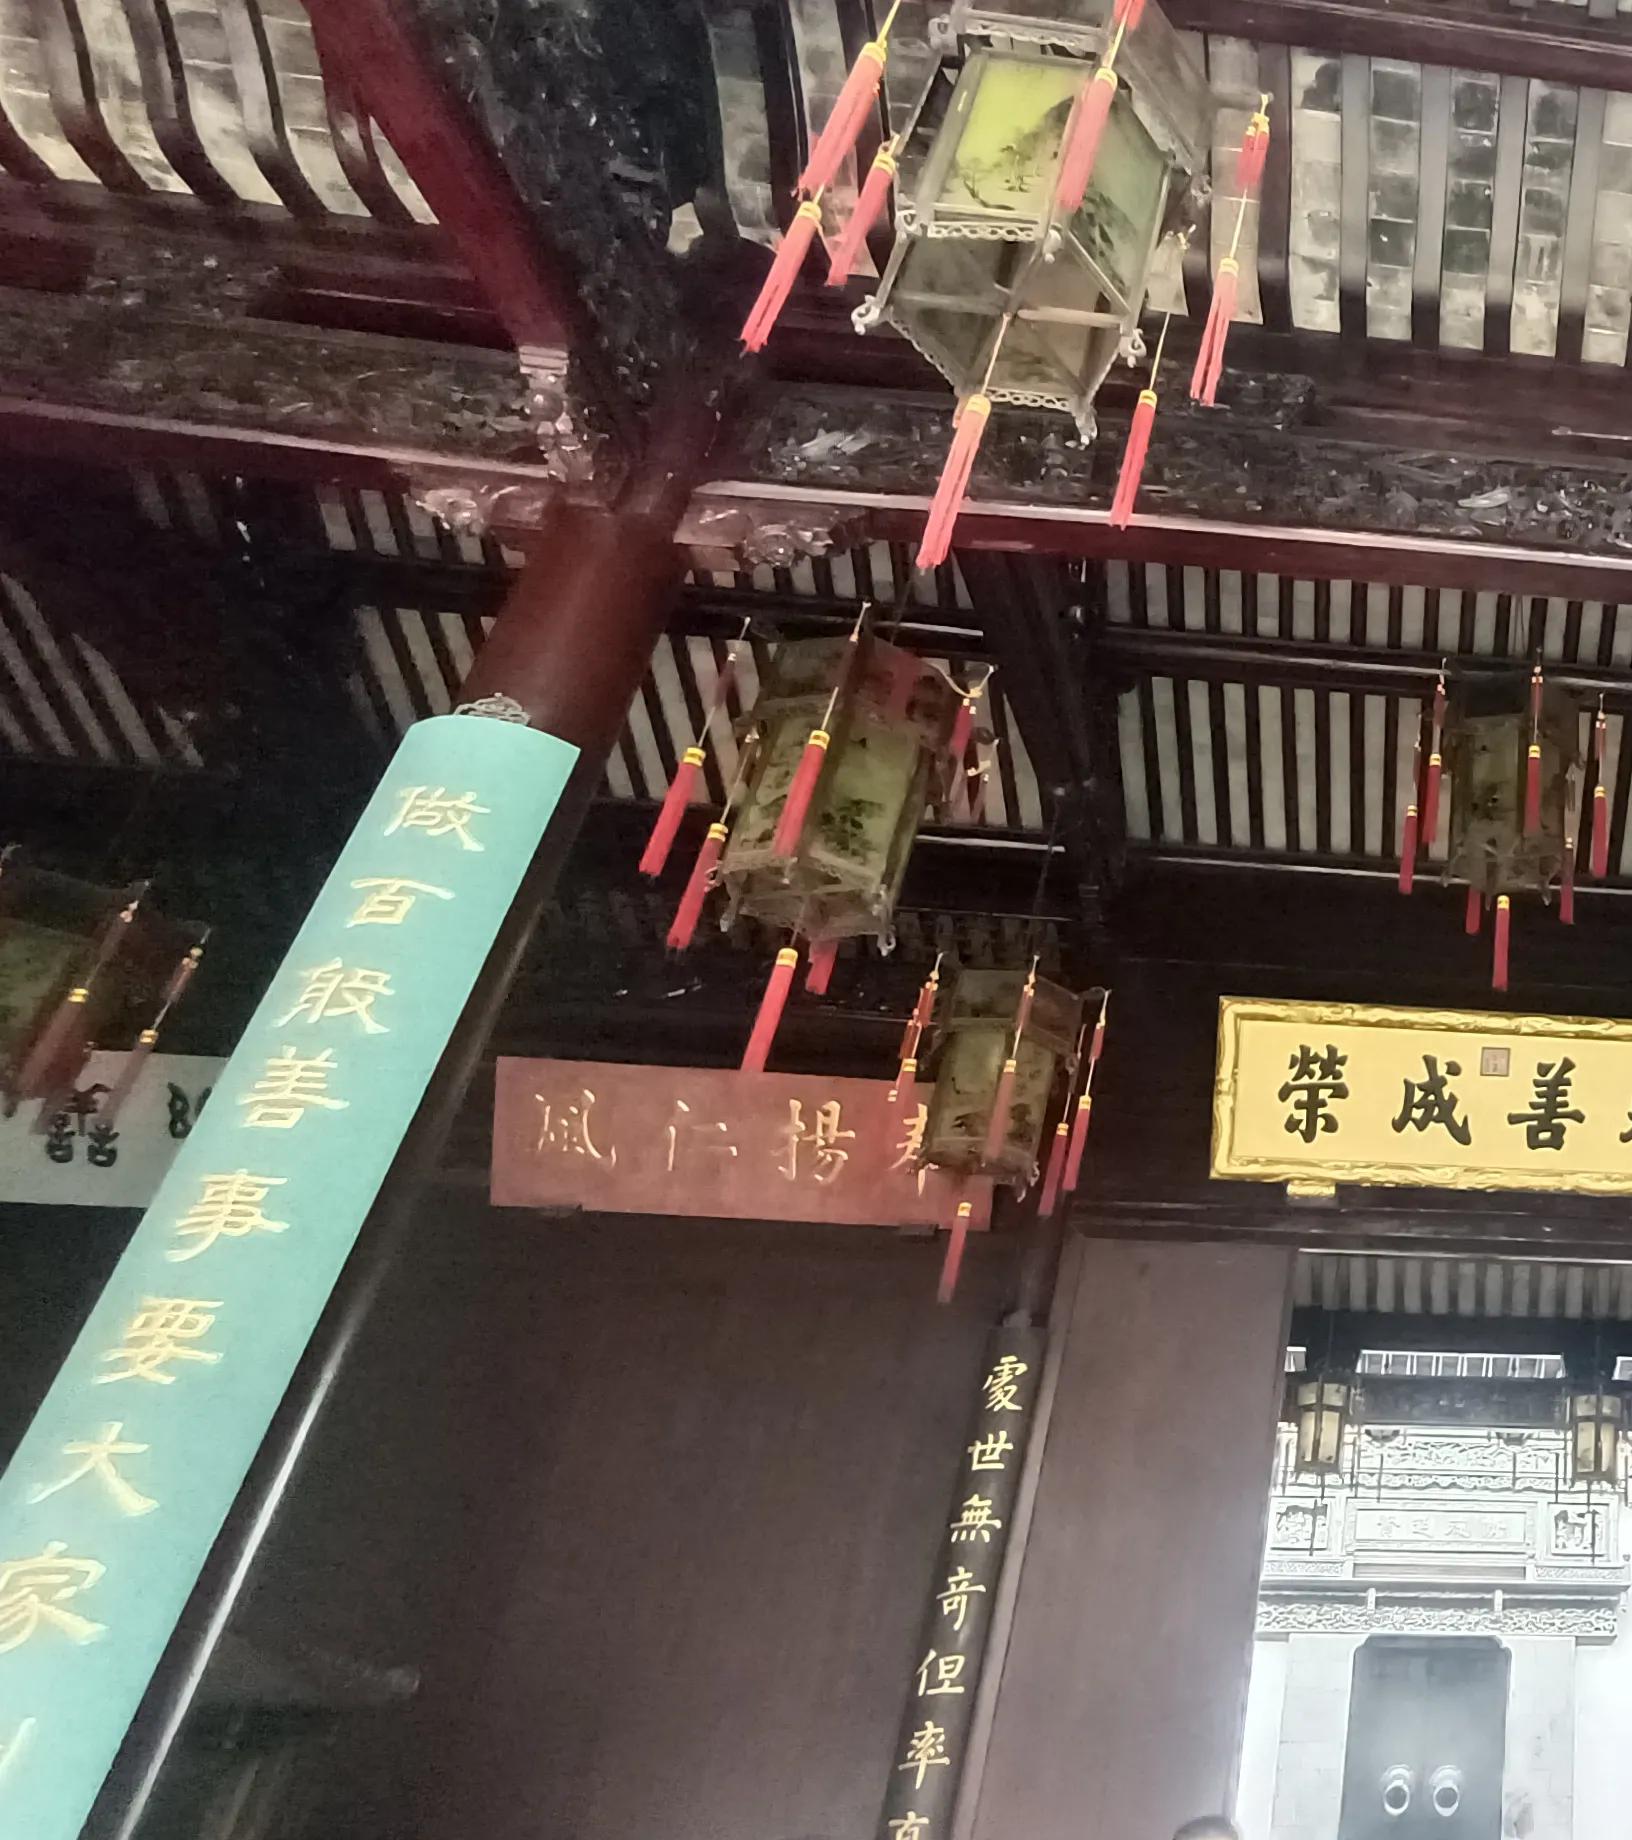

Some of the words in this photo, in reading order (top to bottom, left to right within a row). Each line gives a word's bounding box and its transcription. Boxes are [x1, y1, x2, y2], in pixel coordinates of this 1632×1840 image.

[0, 785, 491, 1780] 做百般善事要大家
